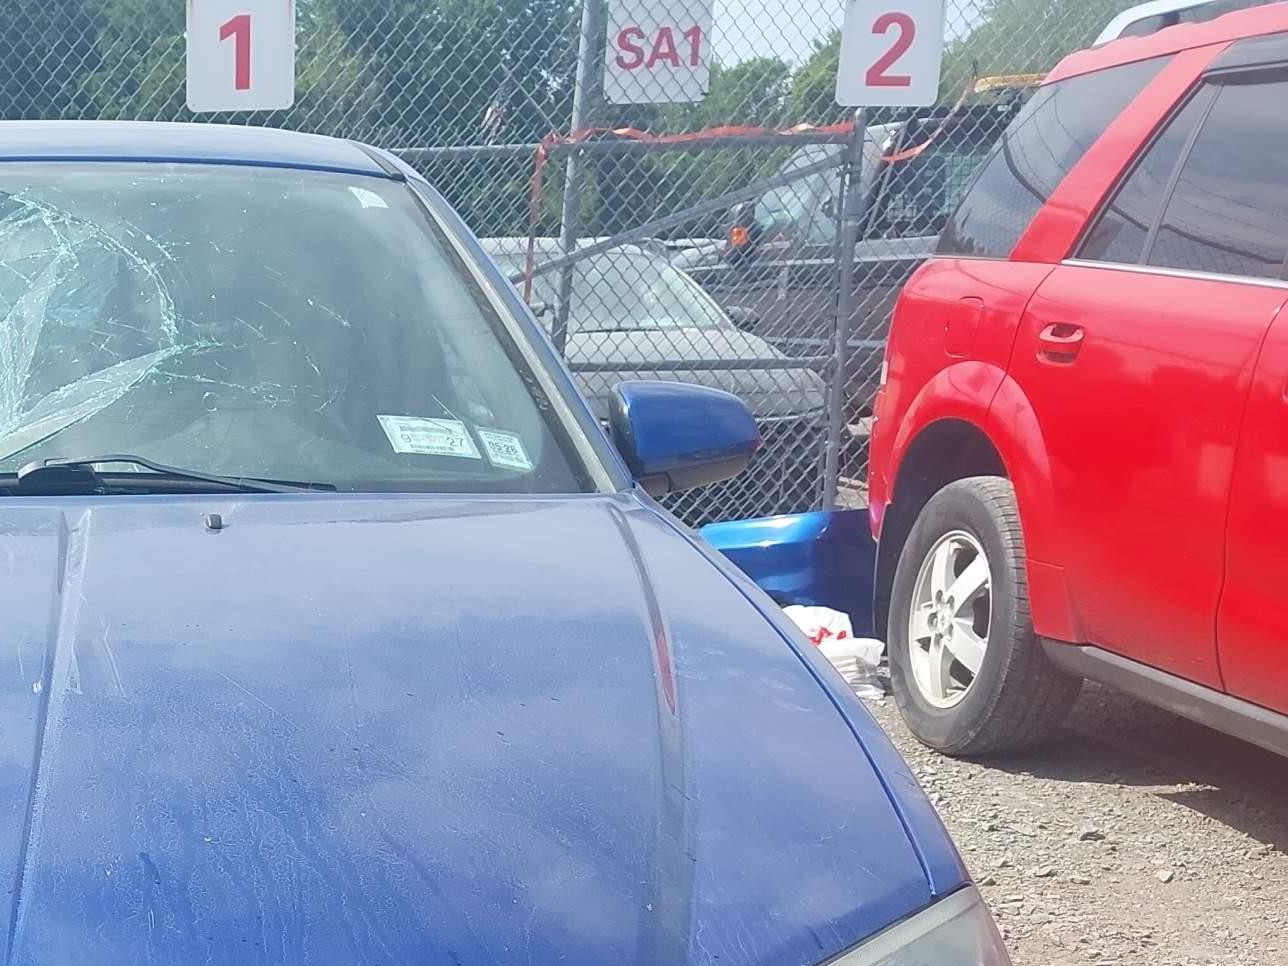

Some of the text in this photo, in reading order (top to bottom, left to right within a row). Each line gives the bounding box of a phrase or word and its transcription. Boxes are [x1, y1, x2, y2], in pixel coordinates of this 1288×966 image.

[219, 15, 251, 90] 1
[616, 26, 701, 69] SA1
[865, 12, 916, 87] 2
[446, 437, 464, 448] 27
